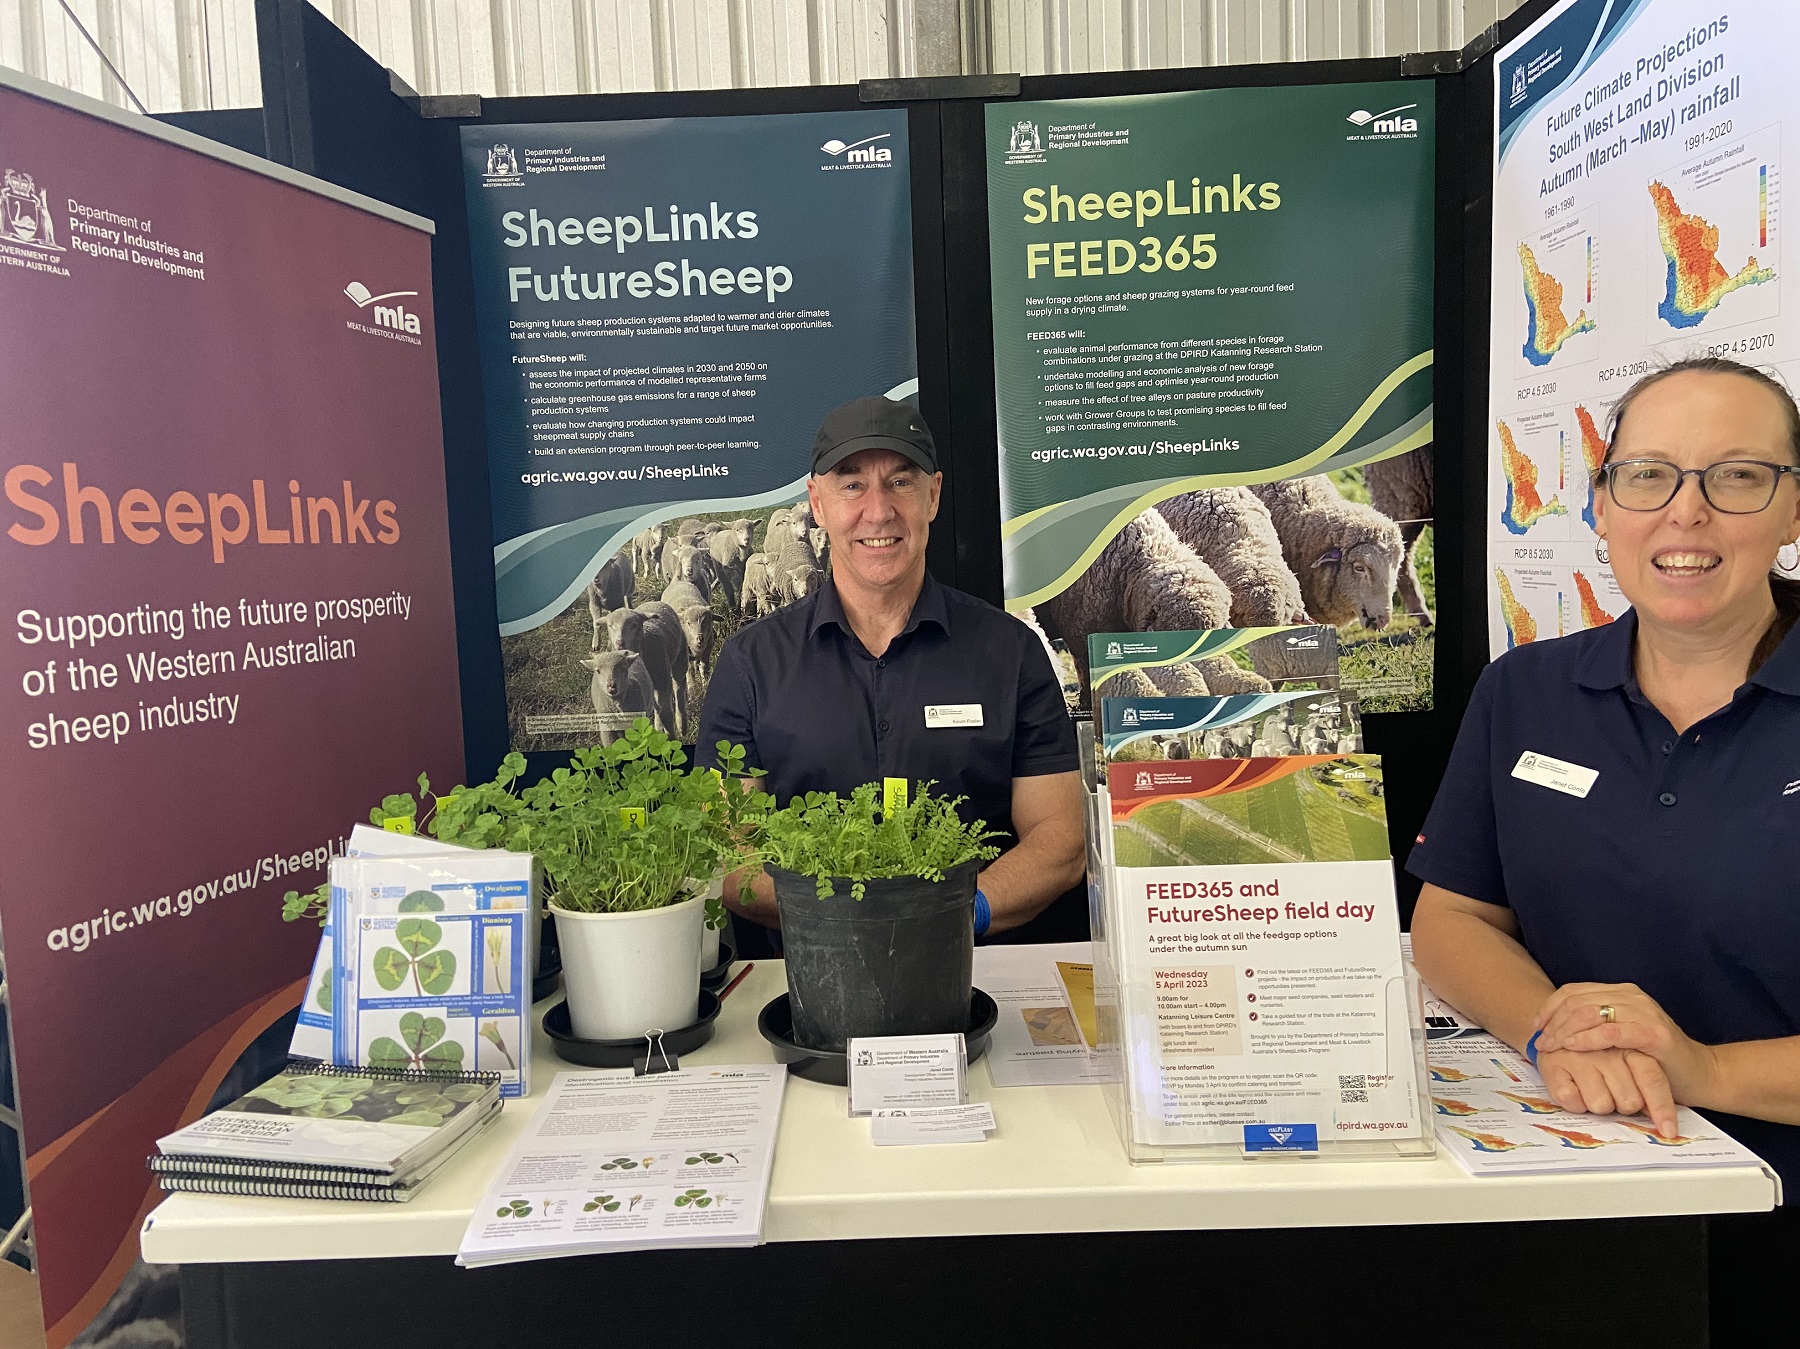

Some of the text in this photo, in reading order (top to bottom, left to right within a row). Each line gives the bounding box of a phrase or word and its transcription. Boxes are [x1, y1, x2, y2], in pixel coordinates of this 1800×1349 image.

[1548, 15, 1728, 136] Future Climate Projections
[1550, 53, 1724, 163] South West Land Division
[1049, 124, 1087, 132] Department
[1374, 114, 1417, 132] mla
[1049, 138, 1128, 149] Regional Development
[1540, 163, 1582, 198] Autumn
[1586, 136, 1626, 177] (March
[1682, 75, 1740, 124] rainfall
[1685, 120, 1732, 151] 1991-2020
[525, 148, 563, 157] Department
[847, 145, 892, 163] mla
[1682, 145, 1745, 176] Average Autumn Rainfall
[526, 165, 557, 174] Regional
[1023, 174, 1280, 227] SheepLinks
[1545, 196, 1574, 219] 1961-1990
[68, 199, 151, 232] Department of
[503, 202, 758, 253] SheepLinks
[70, 218, 203, 263] Primary Industries and
[72, 236, 204, 280] Regional Development
[1028, 234, 1216, 278] FEED365
[509, 261, 792, 302] FutureSheep
[1046, 296, 1071, 305] forage
[1074, 295, 1102, 304] options
[1105, 293, 1120, 301] and
[1123, 292, 1147, 300] sheep
[1150, 290, 1179, 300] grazing
[1182, 289, 1214, 298] systems
[1230, 284, 1273, 295] year-round
[1276, 283, 1293, 291] feed
[374, 306, 421, 334] mla
[510, 320, 549, 329] Designing
[552, 319, 575, 327] future
[577, 319, 601, 327] sheep
[604, 317, 646, 327] production
[648, 316, 681, 325] systems
[683, 314, 715, 323] adapted
[727, 314, 757, 324] warmer
[760, 311, 774, 323] and
[797, 310, 829, 322] climates
[1026, 308, 1052, 317] supply
[1071, 306, 1095, 315] drying
[1098, 304, 1128, 312] climate.
[347, 321, 361, 331] MEAT
[367, 327, 394, 340] LIVESTOCK
[395, 334, 421, 345] AUSTRALIA
[528, 329, 540, 338] are
[543, 329, 569, 338] viable,
[572, 327, 634, 337] environmentally
[637, 325, 681, 335] sustainable
[684, 325, 698, 333] and
[701, 325, 724, 334] target
[781, 320, 833, 330] opportunities.
[1708, 334, 1775, 358] RCP 4.5 2070
[1599, 361, 1648, 382] RCP 4.5 2050
[1518, 382, 1556, 400] RCP 4.5 2030
[1032, 439, 1239, 462] agric.wa.gov.au/SheepLinks
[522, 464, 728, 486] agric.wa.gov.au/SheepLinks
[5, 463, 399, 563] SheepLinks
[1515, 549, 1554, 559] RCP 8.5 2030
[18, 591, 410, 648] Supporting the future prosperity
[23, 638, 355, 696] of the Western Australian
[28, 693, 239, 748] sheep industry
[1550, 779, 1567, 787] Janet
[47, 836, 350, 952] agric.wa.gov.au/SheepLi
[1146, 879, 1278, 899] FEED365 and
[1148, 901, 1374, 924] FutureSheep field day
[1157, 935, 1182, 944] great
[1184, 934, 1198, 943] big
[1234, 932, 1243, 940] all
[1263, 931, 1301, 940] feedgap
[1304, 931, 1337, 939] options
[1155, 970, 1207, 979] Wednesday
[1164, 981, 1183, 990] April
[210, 1117, 294, 1128] OESTROGENIC
[240, 1129, 280, 1137] GUIDE
[1337, 1121, 1408, 1131] dpird.wa.gov.au
